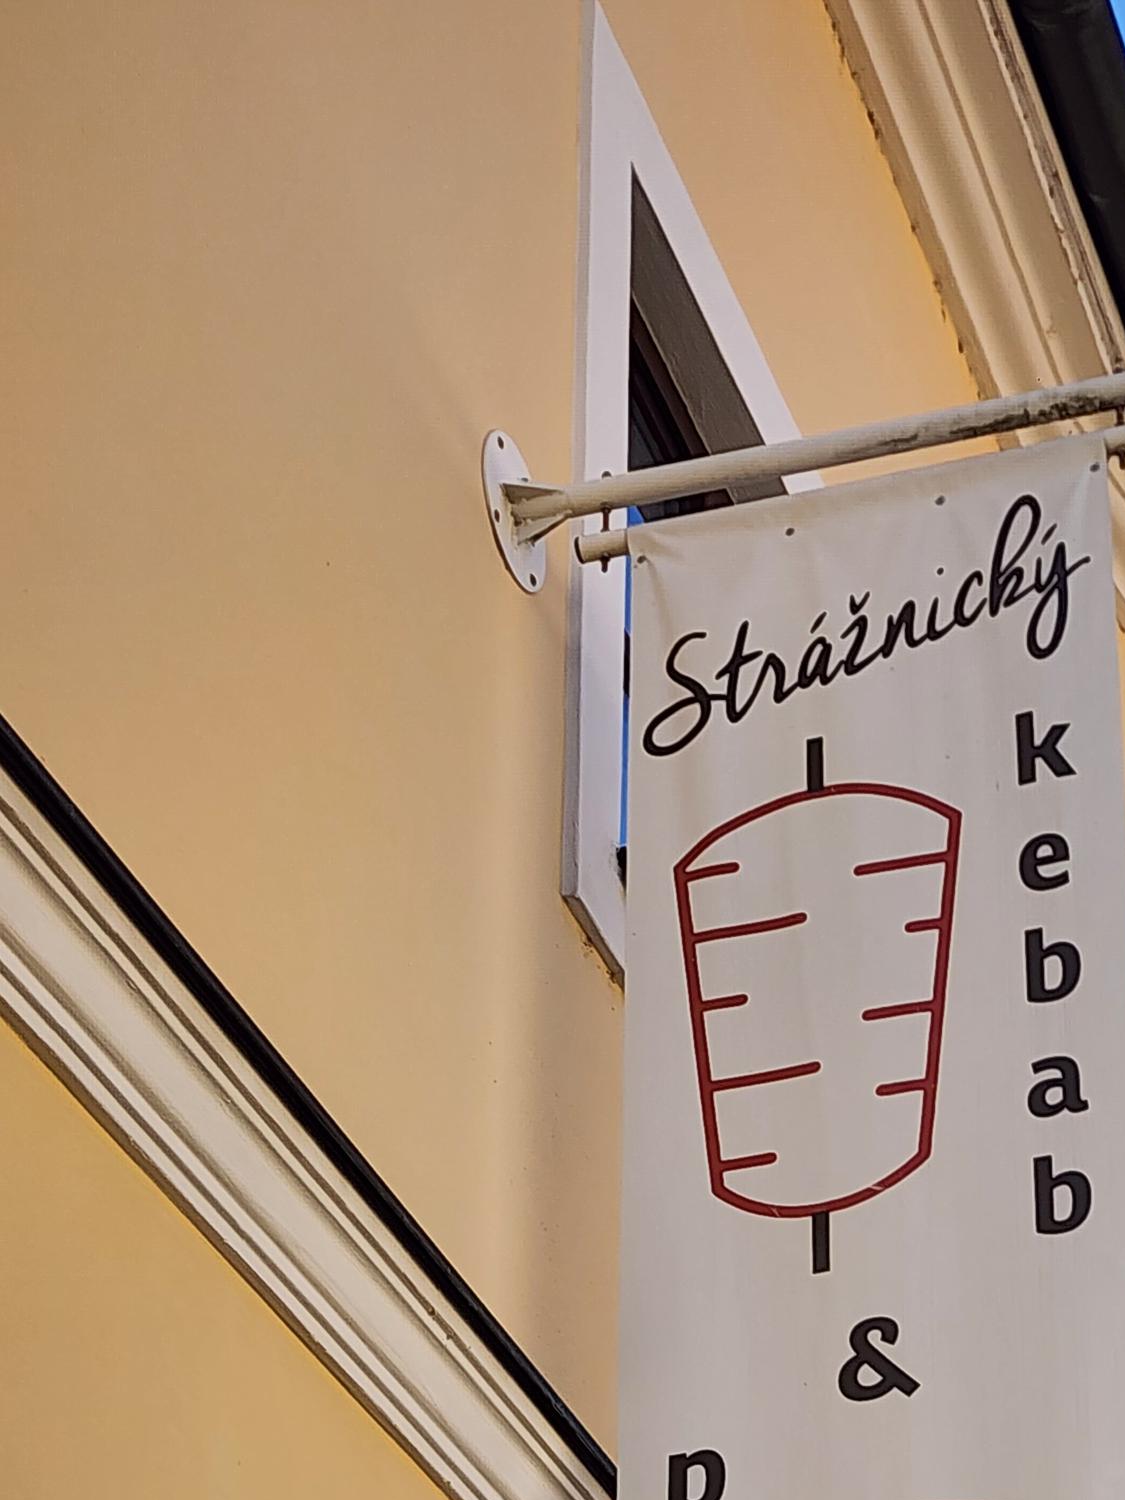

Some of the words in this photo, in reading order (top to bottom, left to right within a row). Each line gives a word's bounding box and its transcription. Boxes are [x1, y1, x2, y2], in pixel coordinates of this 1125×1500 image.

[642, 494, 1091, 758] Strážnický
[1015, 711, 1093, 1236] kebab
[838, 1316, 921, 1403] &
